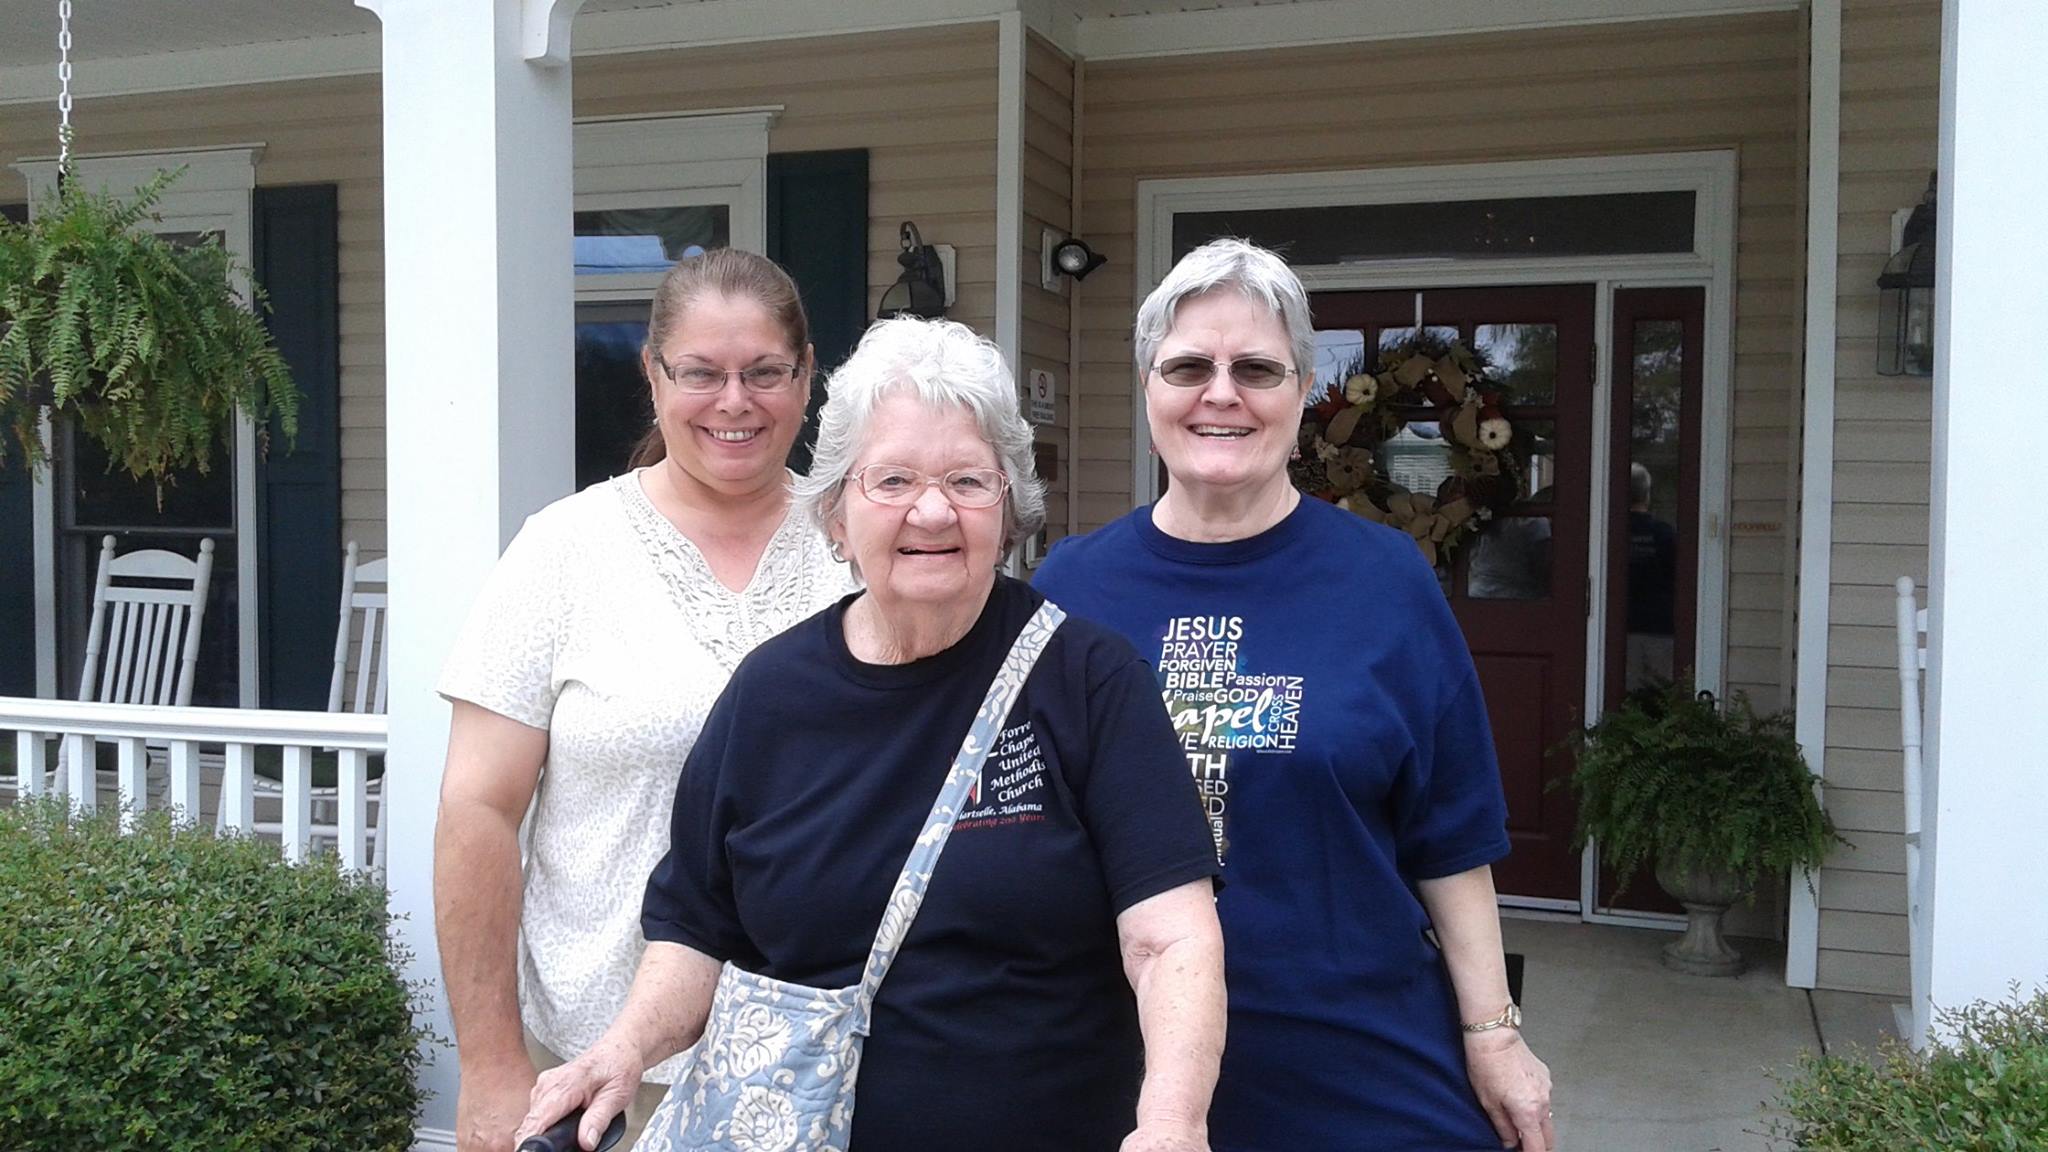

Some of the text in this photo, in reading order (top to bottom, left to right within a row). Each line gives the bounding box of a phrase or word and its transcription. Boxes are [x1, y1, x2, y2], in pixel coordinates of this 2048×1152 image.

[1162, 616, 1244, 642] JESUS
[1161, 642, 1238, 659] PRAYER
[1158, 659, 1237, 672] FORGIVEN
[1166, 671, 1286, 689] BIBLE Passion
[1173, 688, 1259, 704] Praise GOD
[1162, 687, 1274, 745] apel
[1268, 694, 1285, 732] CROSS
[1278, 676, 1304, 750] HEAVEN
[1000, 733, 1035, 756] Chape
[1208, 734, 1279, 749] RELIGION
[998, 745, 1041, 771] United
[1185, 752, 1227, 780] TH
[990, 758, 1047, 791] Methodis
[998, 773, 1044, 802] Church
